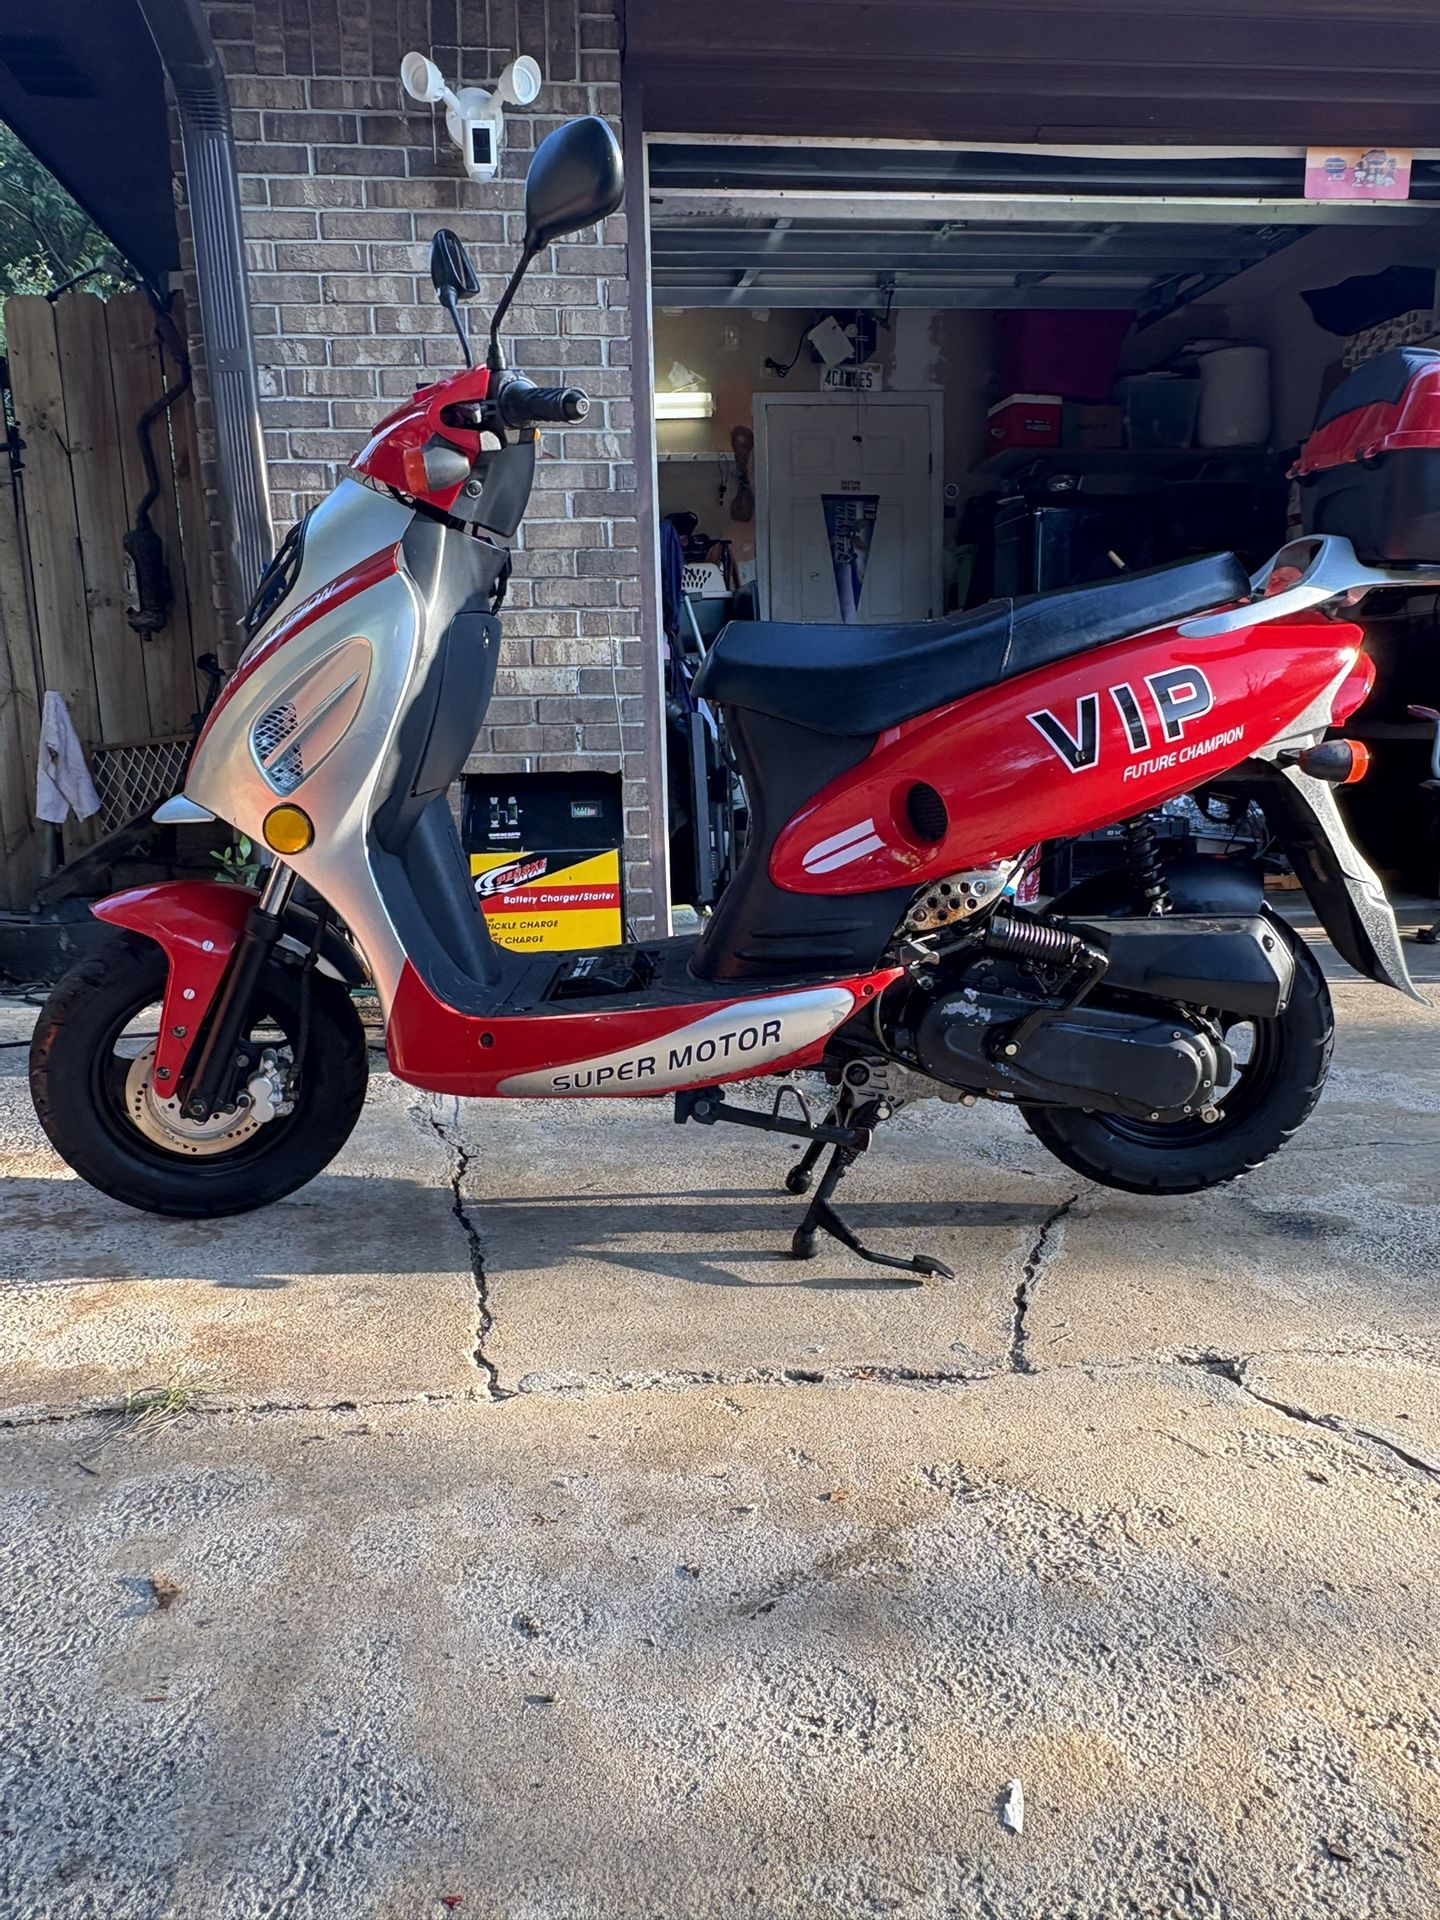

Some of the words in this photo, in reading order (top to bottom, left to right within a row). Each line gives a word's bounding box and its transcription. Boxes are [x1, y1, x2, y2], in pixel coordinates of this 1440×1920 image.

[1025, 664, 1213, 774] VIP
[1123, 751, 1176, 782] FUTURE
[1179, 724, 1244, 766] CHAMPION
[504, 895, 537, 905] Battery
[540, 892, 614, 904] Charger/Starter
[505, 935, 544, 944] CHARGE
[520, 920, 558, 928] CHARGE
[552, 1056, 656, 1091] SUPER
[669, 1019, 782, 1070] MOTOR
